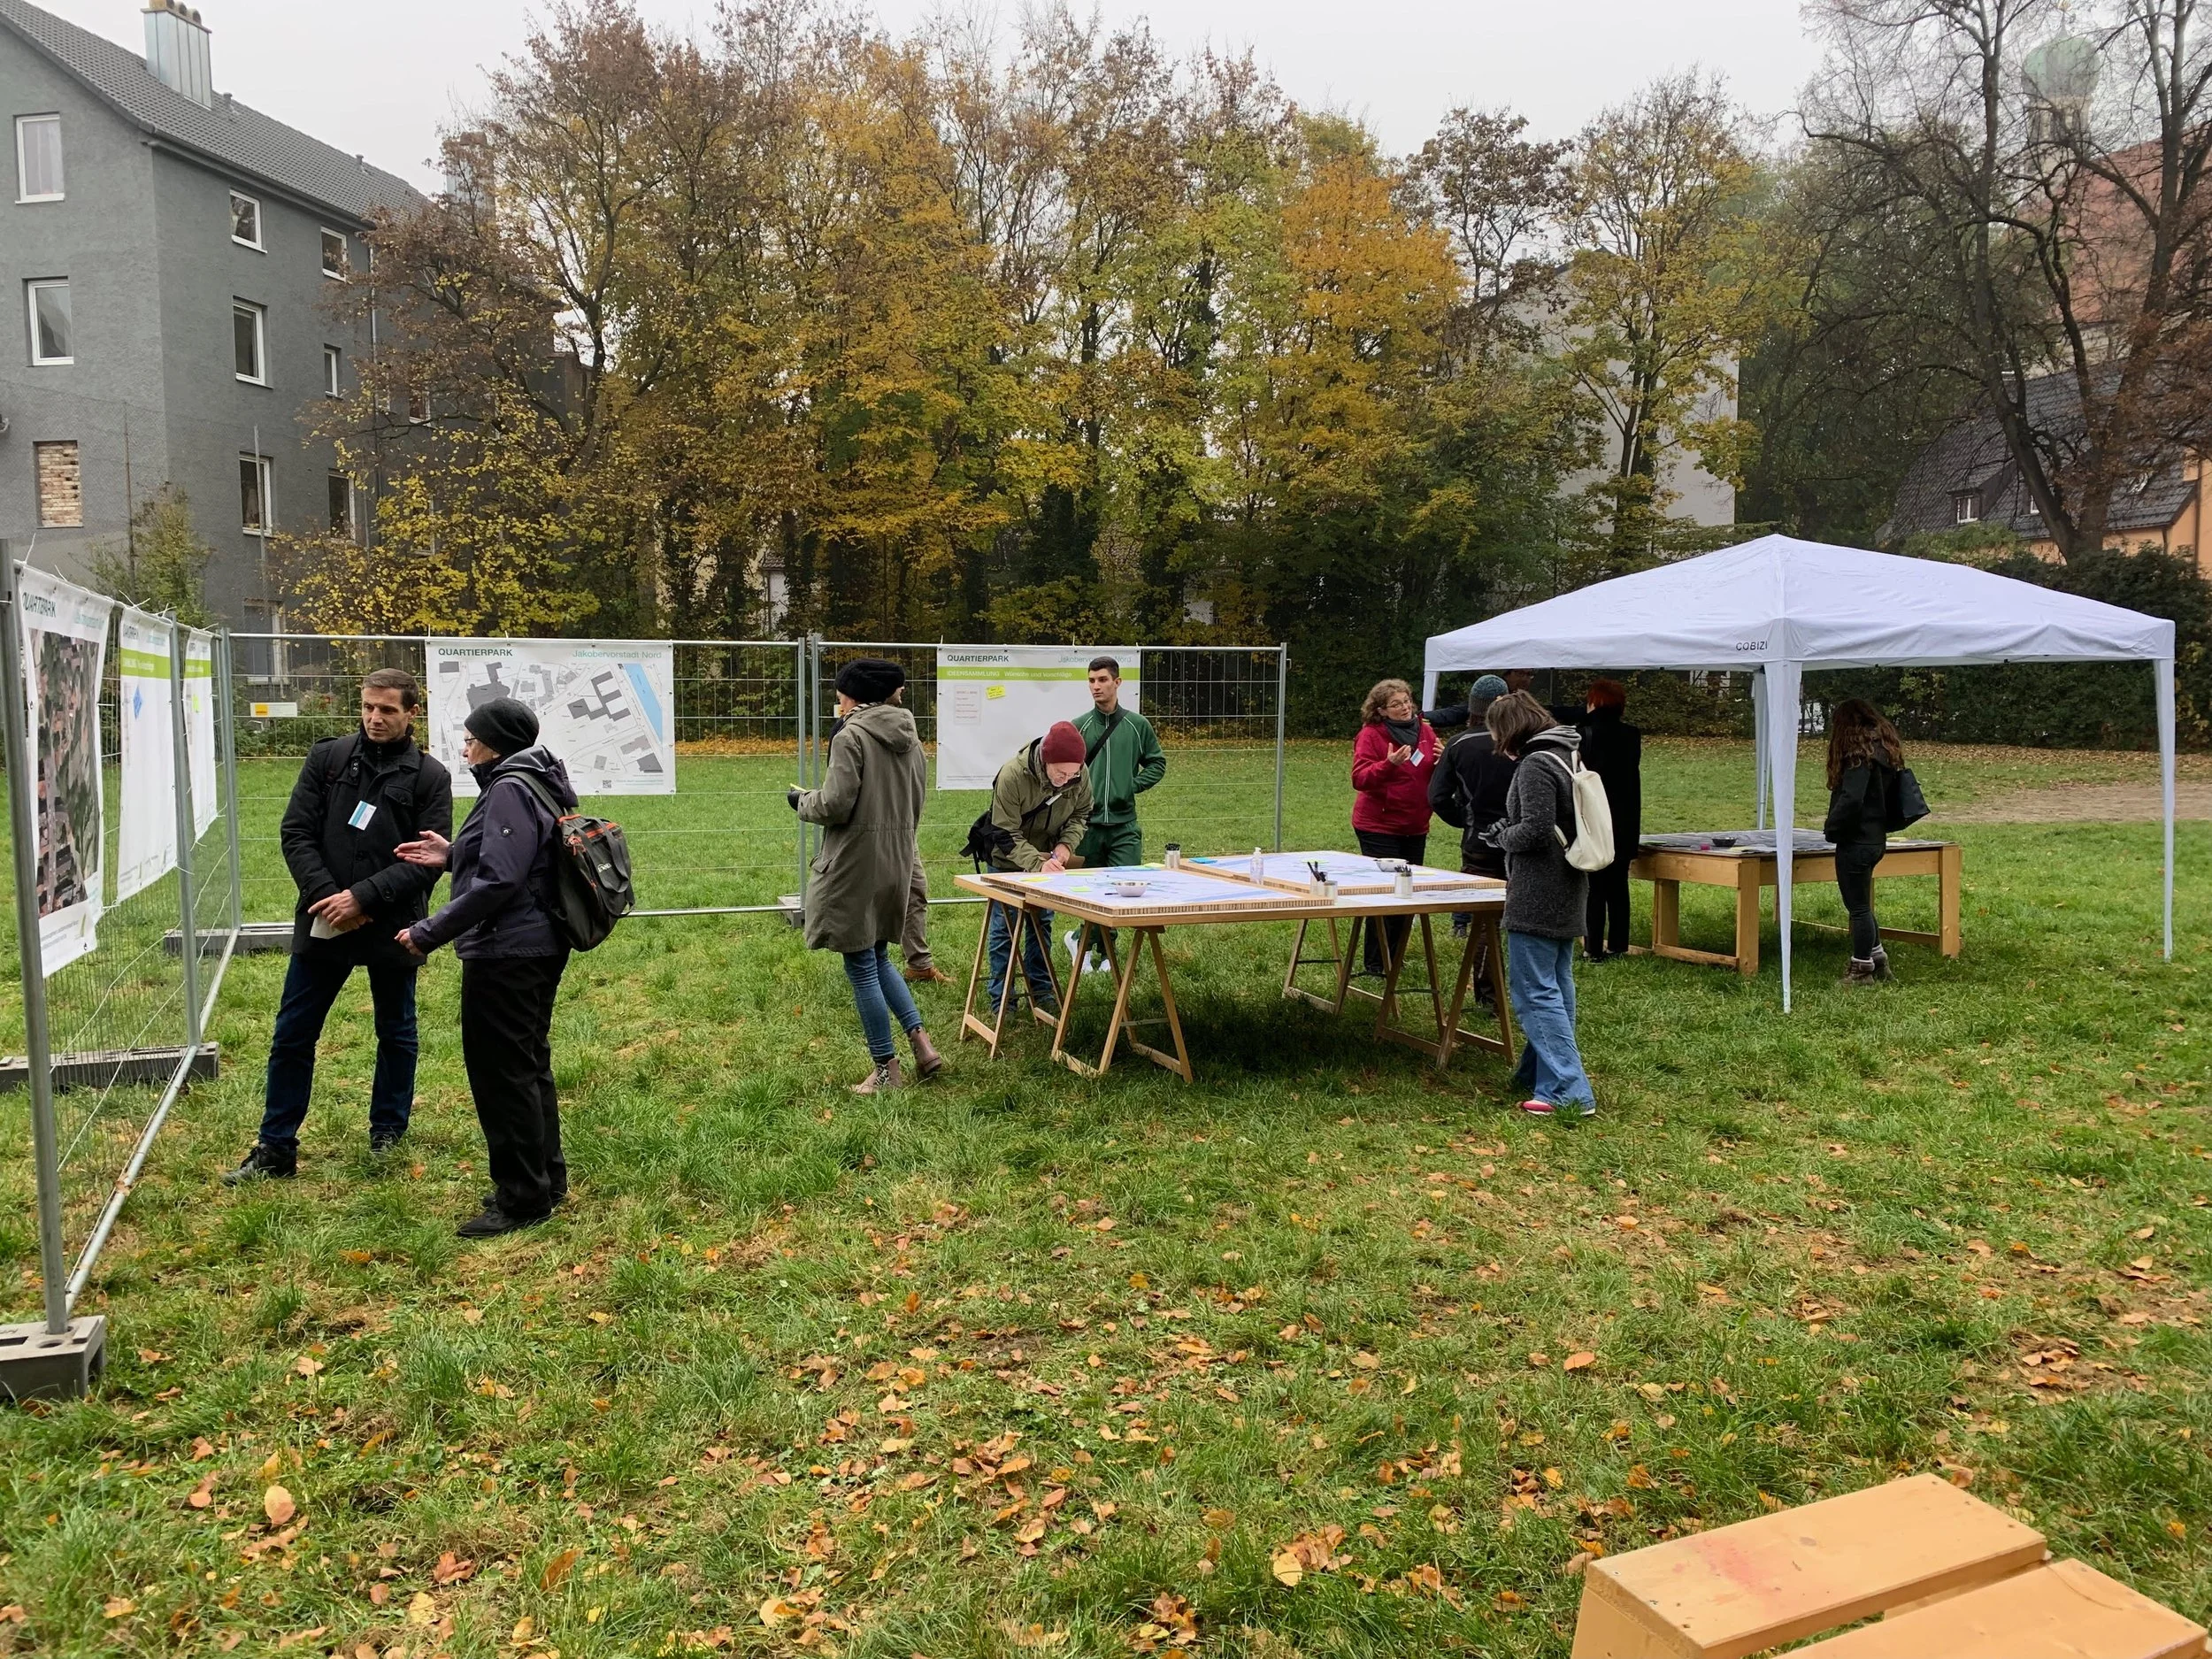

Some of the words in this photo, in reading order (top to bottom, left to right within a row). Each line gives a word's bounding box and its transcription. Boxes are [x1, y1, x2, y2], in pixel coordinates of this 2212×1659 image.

[1735, 641, 1768, 651] COBIZI
[438, 648, 513, 657] QUARTIERPARK
[947, 654, 1010, 663] QUARTIERPARK
[1115, 655, 1132, 664] Nord
